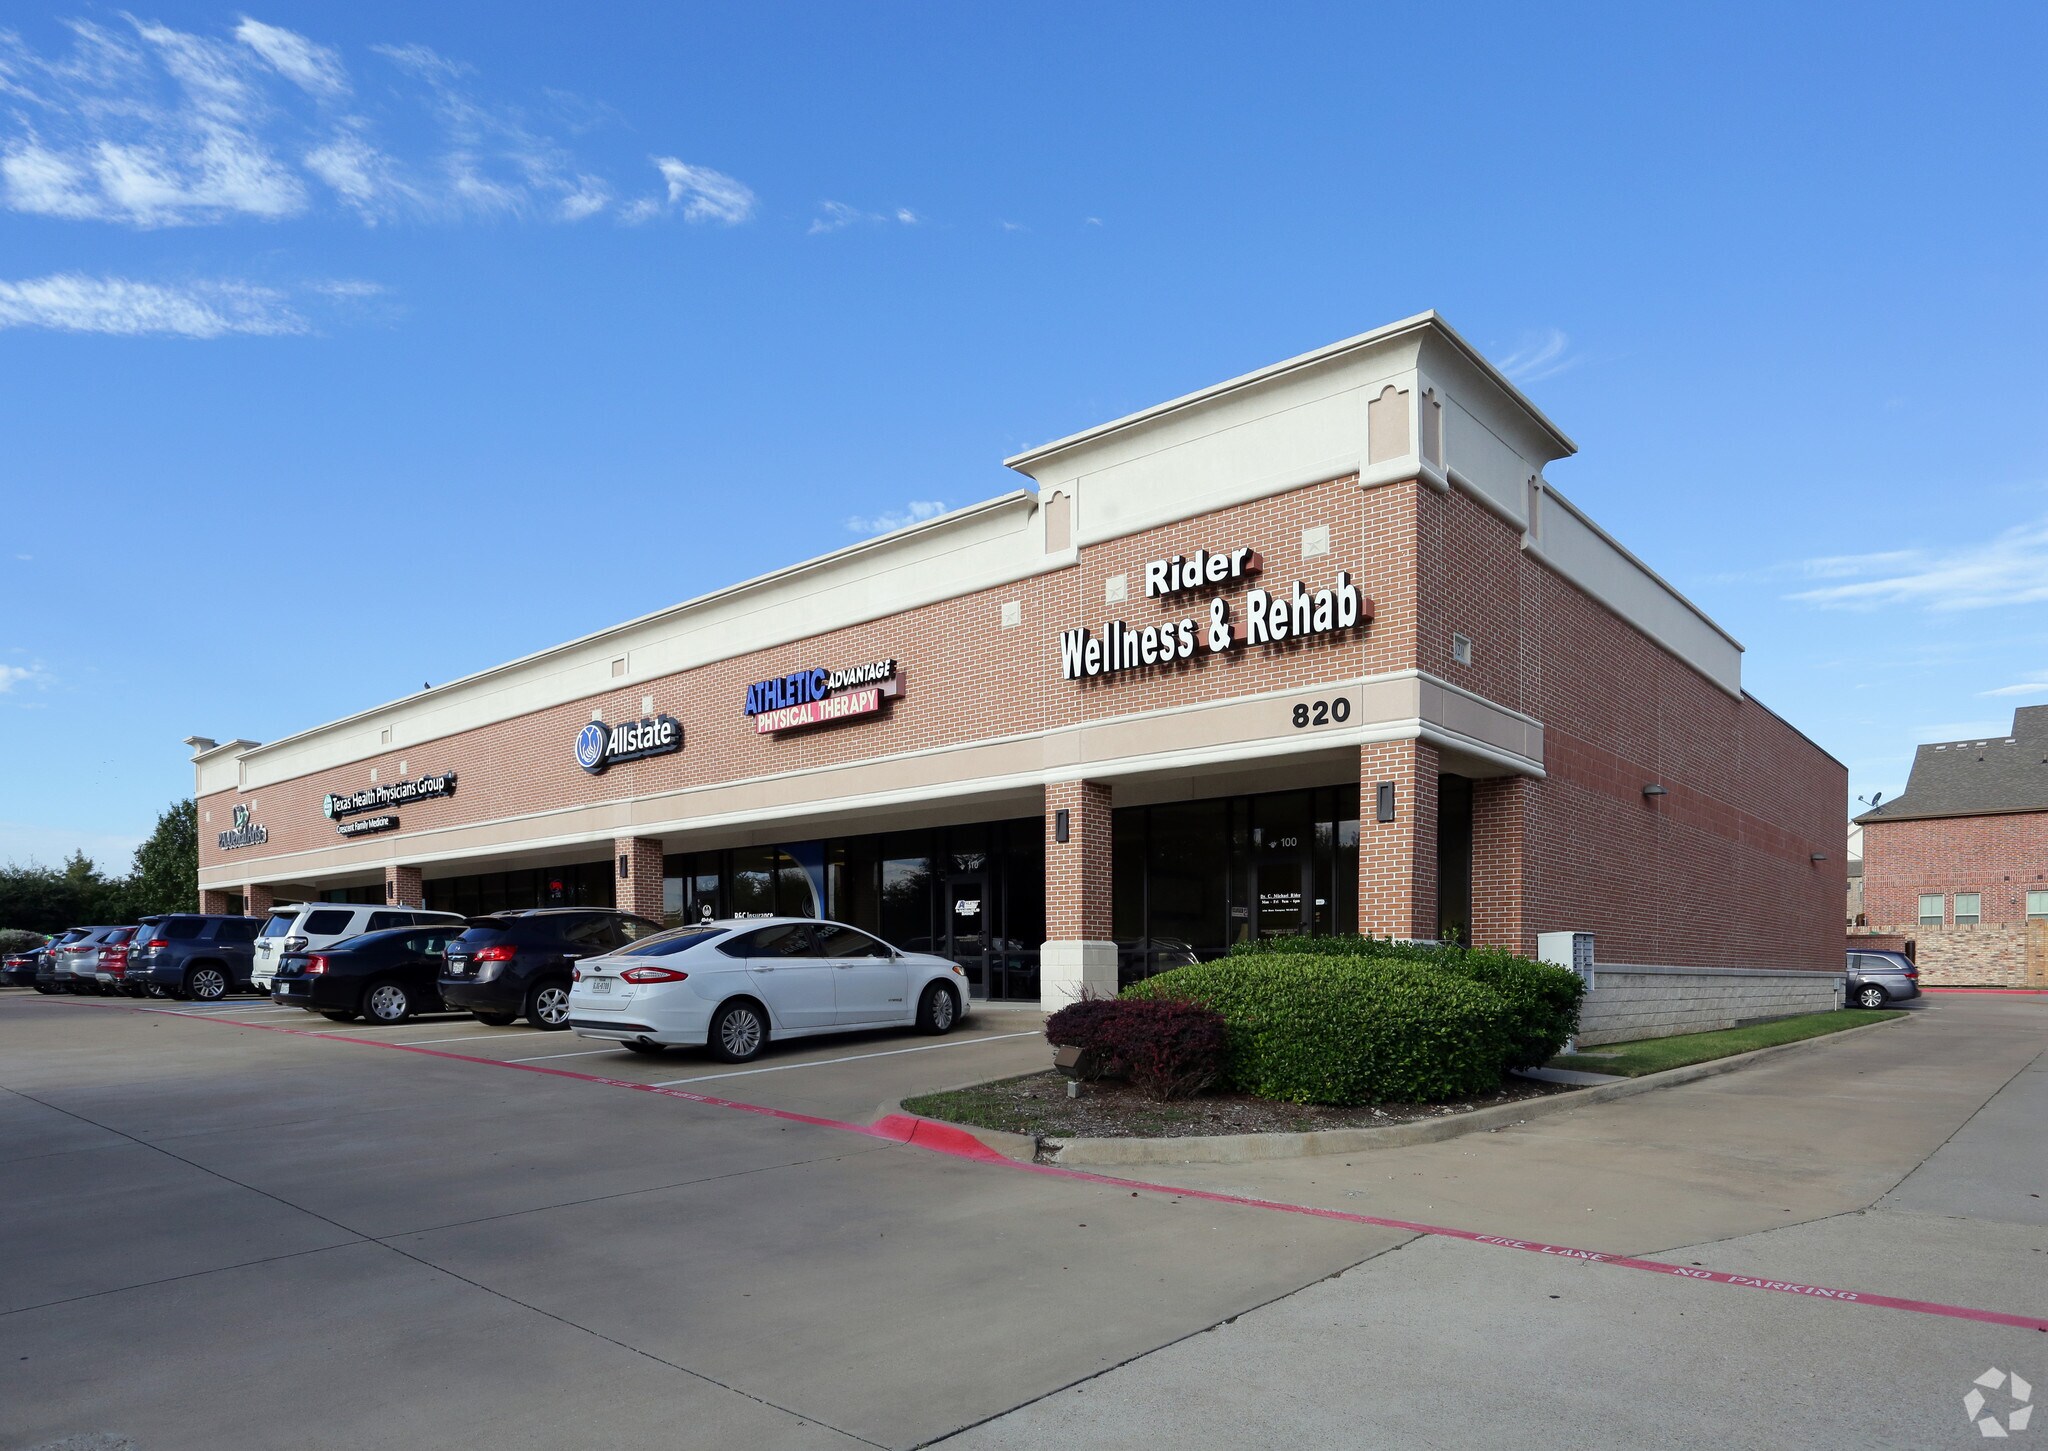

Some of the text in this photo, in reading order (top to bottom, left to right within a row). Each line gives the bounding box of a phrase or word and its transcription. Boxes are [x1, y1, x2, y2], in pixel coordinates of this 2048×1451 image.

[1145, 548, 1251, 598] Rider
[1060, 571, 1358, 680] Wellness & Rehab
[744, 659, 890, 715] ATHLETIC ADVANTAGE
[757, 690, 876, 732] PHYSICAL THERAPY
[1292, 698, 1350, 728] 820
[605, 719, 672, 756] Allstate
[333, 798, 351, 812] Texas
[352, 789, 375, 808] Health
[376, 782, 416, 802] Physicians
[417, 777, 445, 794] Group
[336, 817, 389, 834] Crescent Family Medicine
[1280, 837, 1297, 847] 100
[1475, 1234, 1610, 1262] FIRE LANE
[1673, 1267, 1858, 1300] NO PARKING
